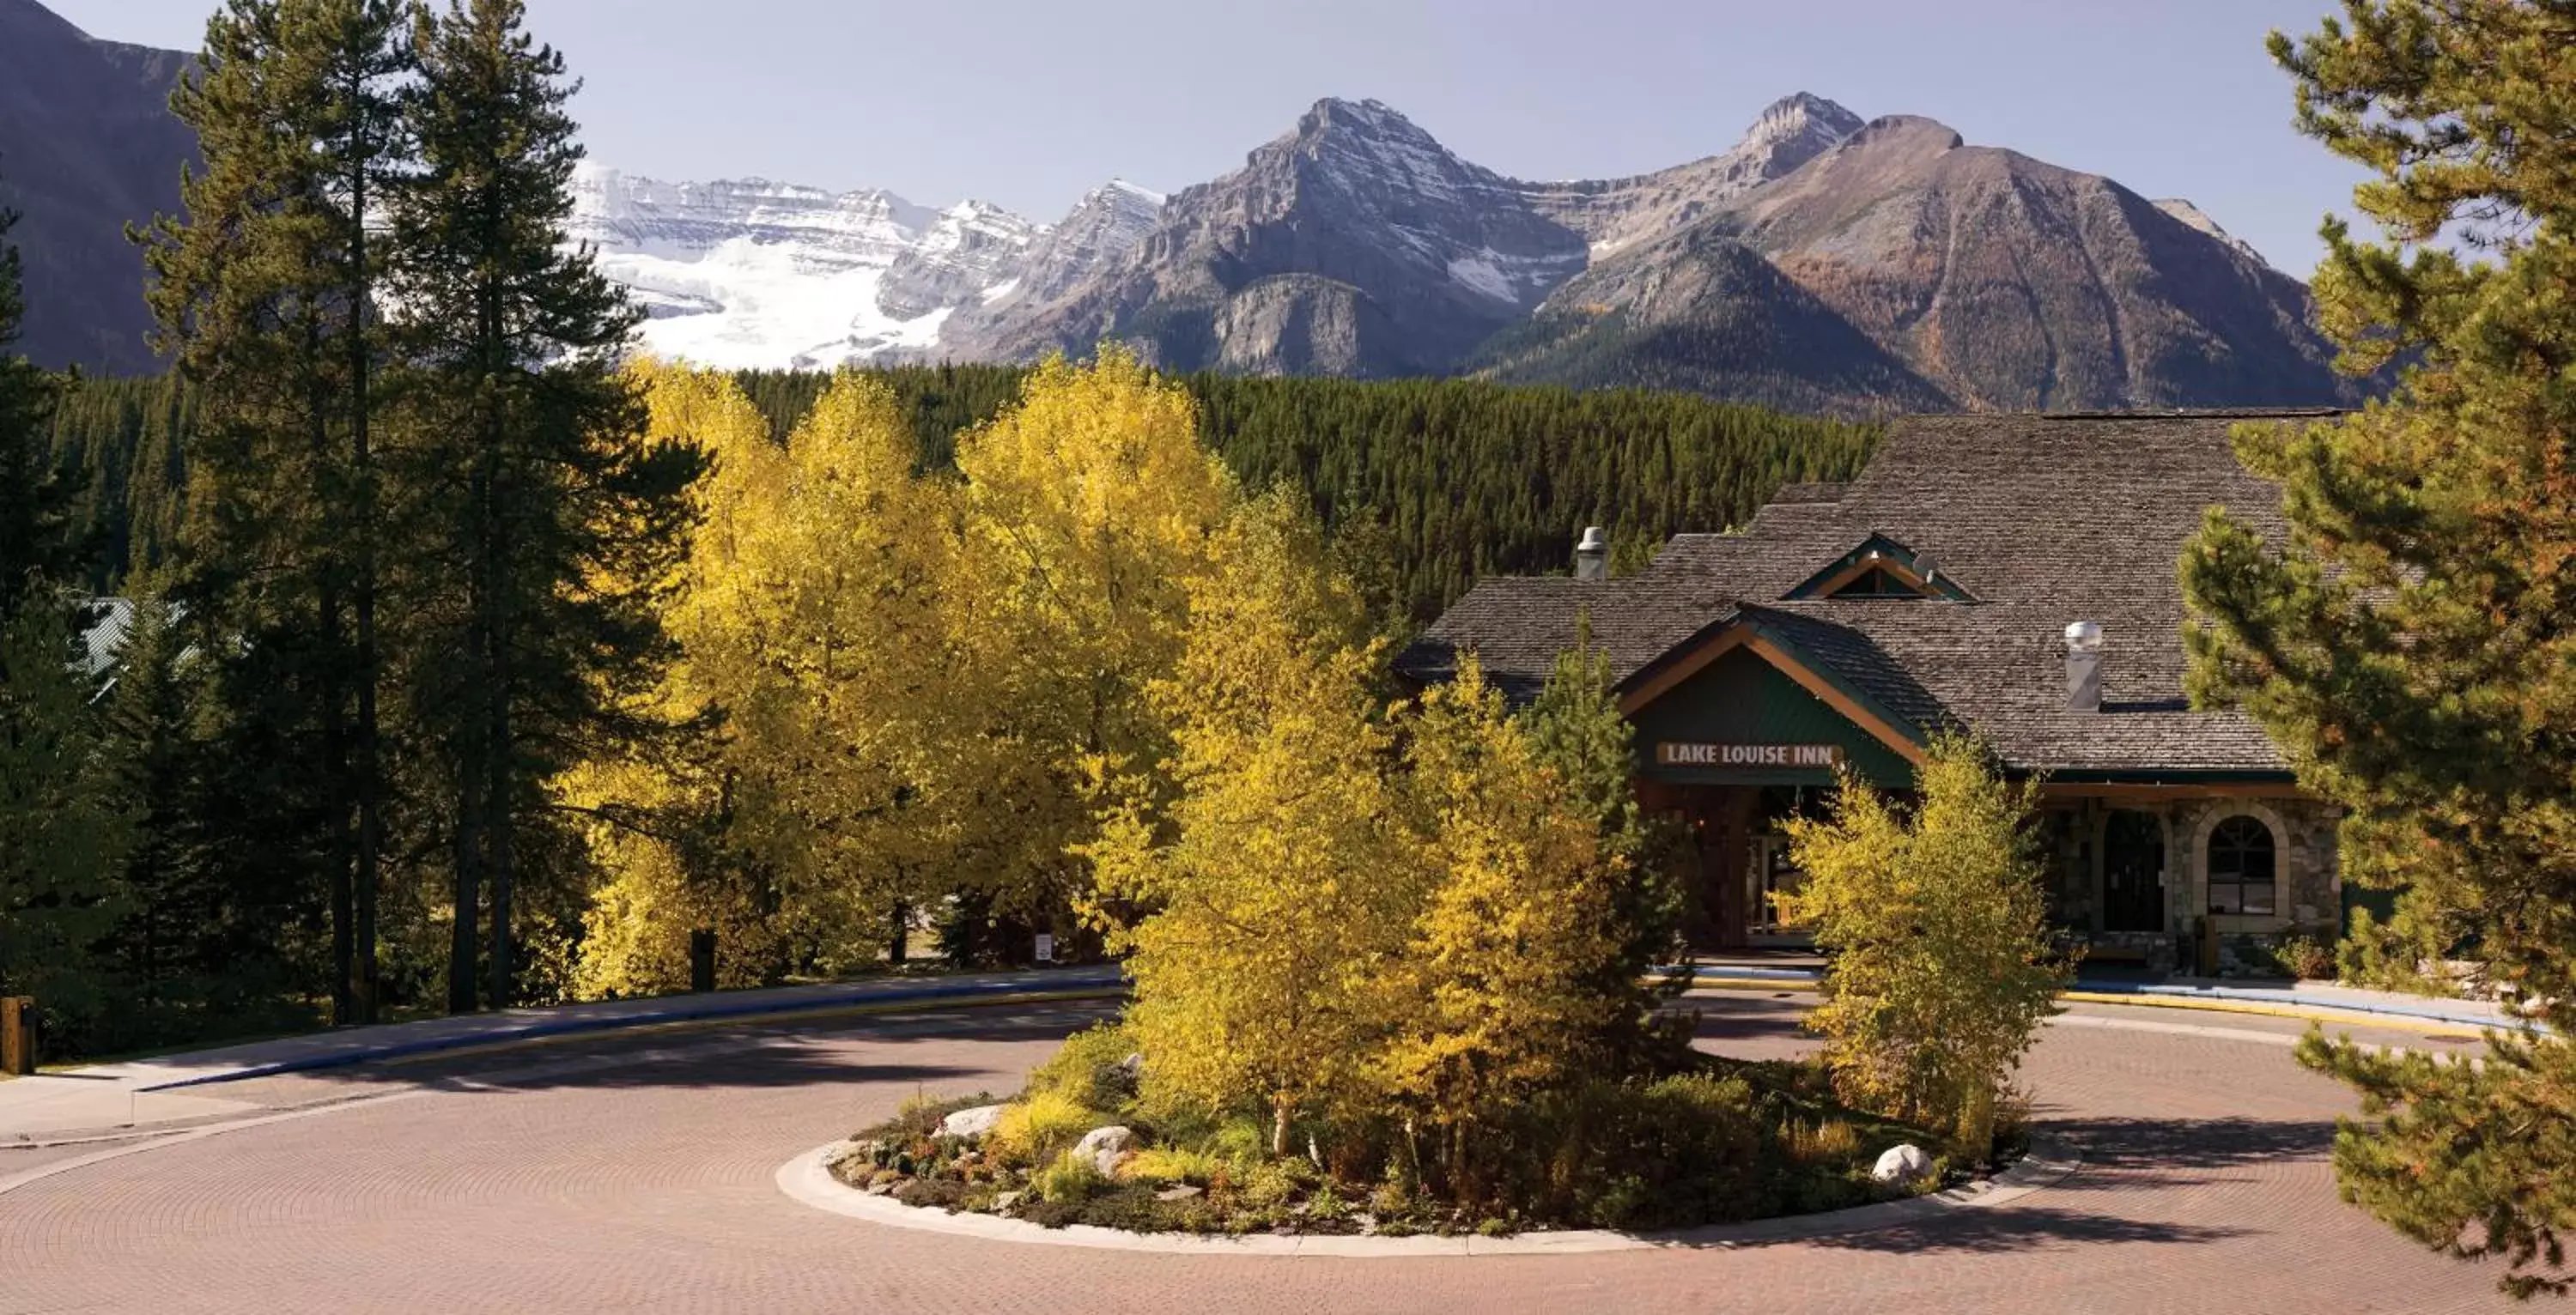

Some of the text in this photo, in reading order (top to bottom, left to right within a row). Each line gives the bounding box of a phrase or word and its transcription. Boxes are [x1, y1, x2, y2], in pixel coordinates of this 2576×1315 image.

[1668, 744, 1832, 765] LAKE LOUISE INN
